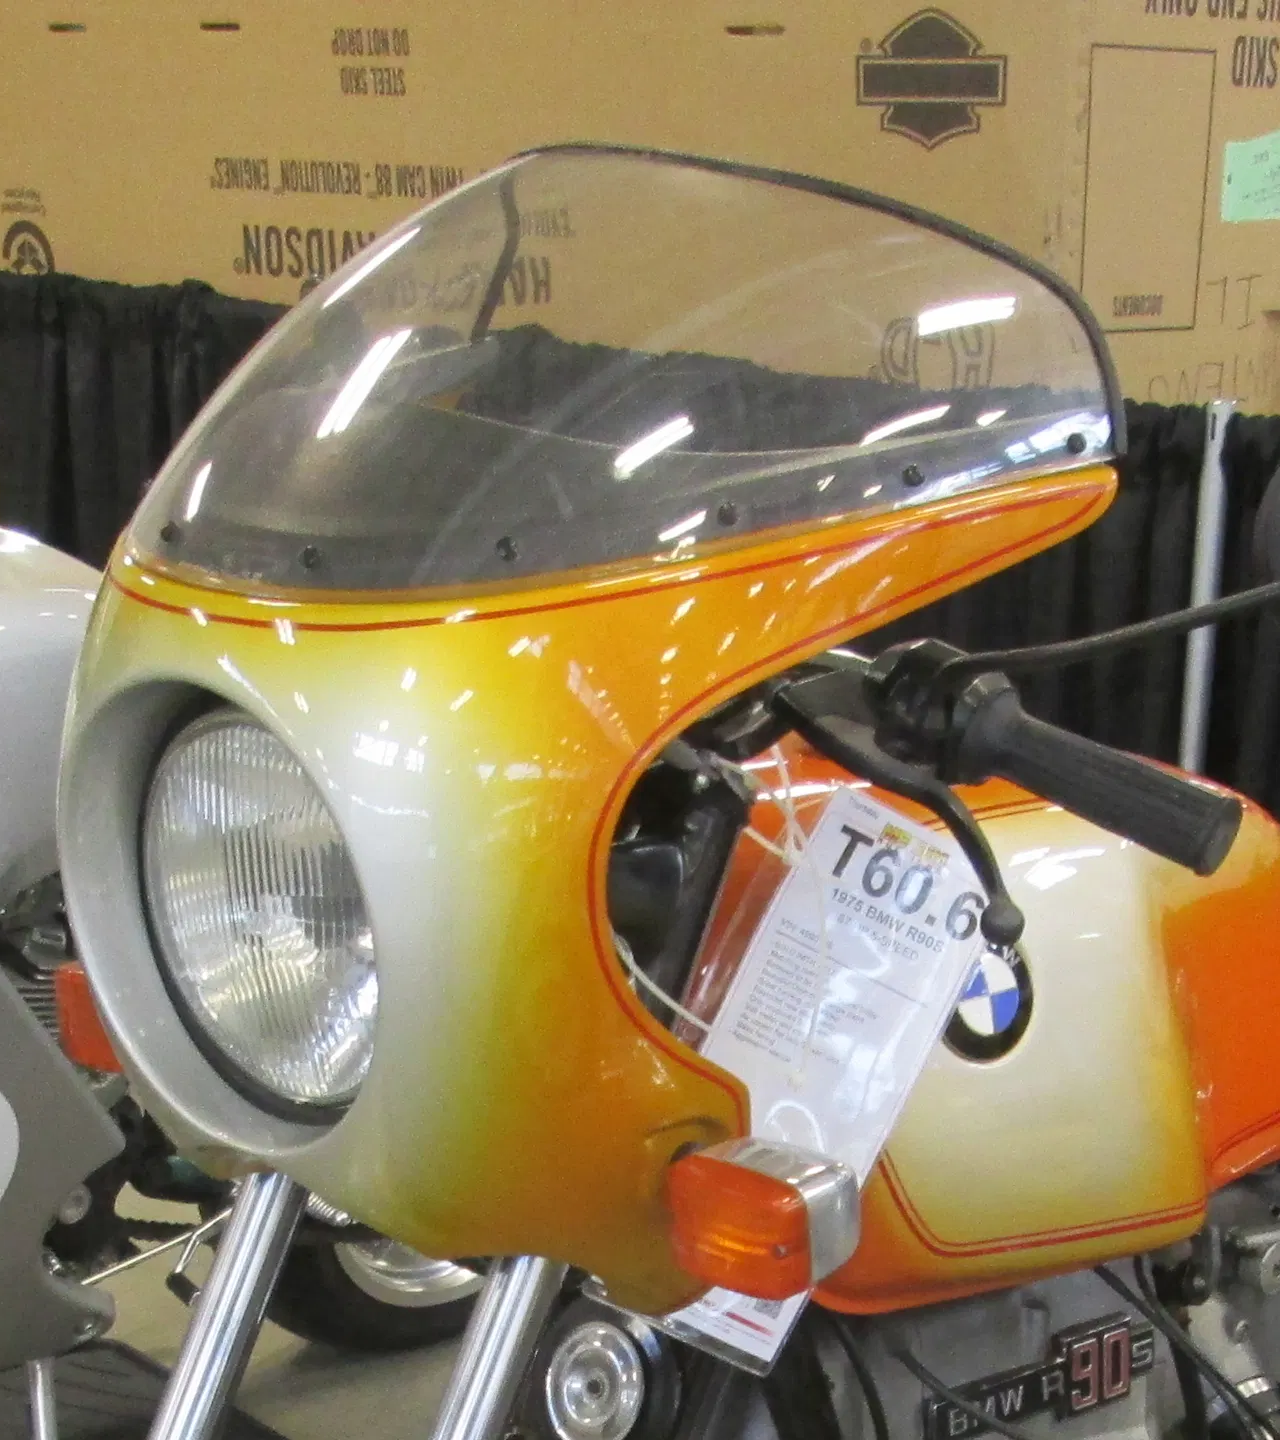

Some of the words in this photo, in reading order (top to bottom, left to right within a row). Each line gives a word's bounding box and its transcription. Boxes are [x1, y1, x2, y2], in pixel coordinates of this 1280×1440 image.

[339, 66, 368, 96] SKID
[1230, 34, 1280, 90] SKID
[370, 67, 406, 97] STEEL
[395, 165, 426, 198] CAM
[830, 824, 985, 941] T60.6
[830, 888, 865, 912] 1975
[865, 905, 904, 932] BMW
